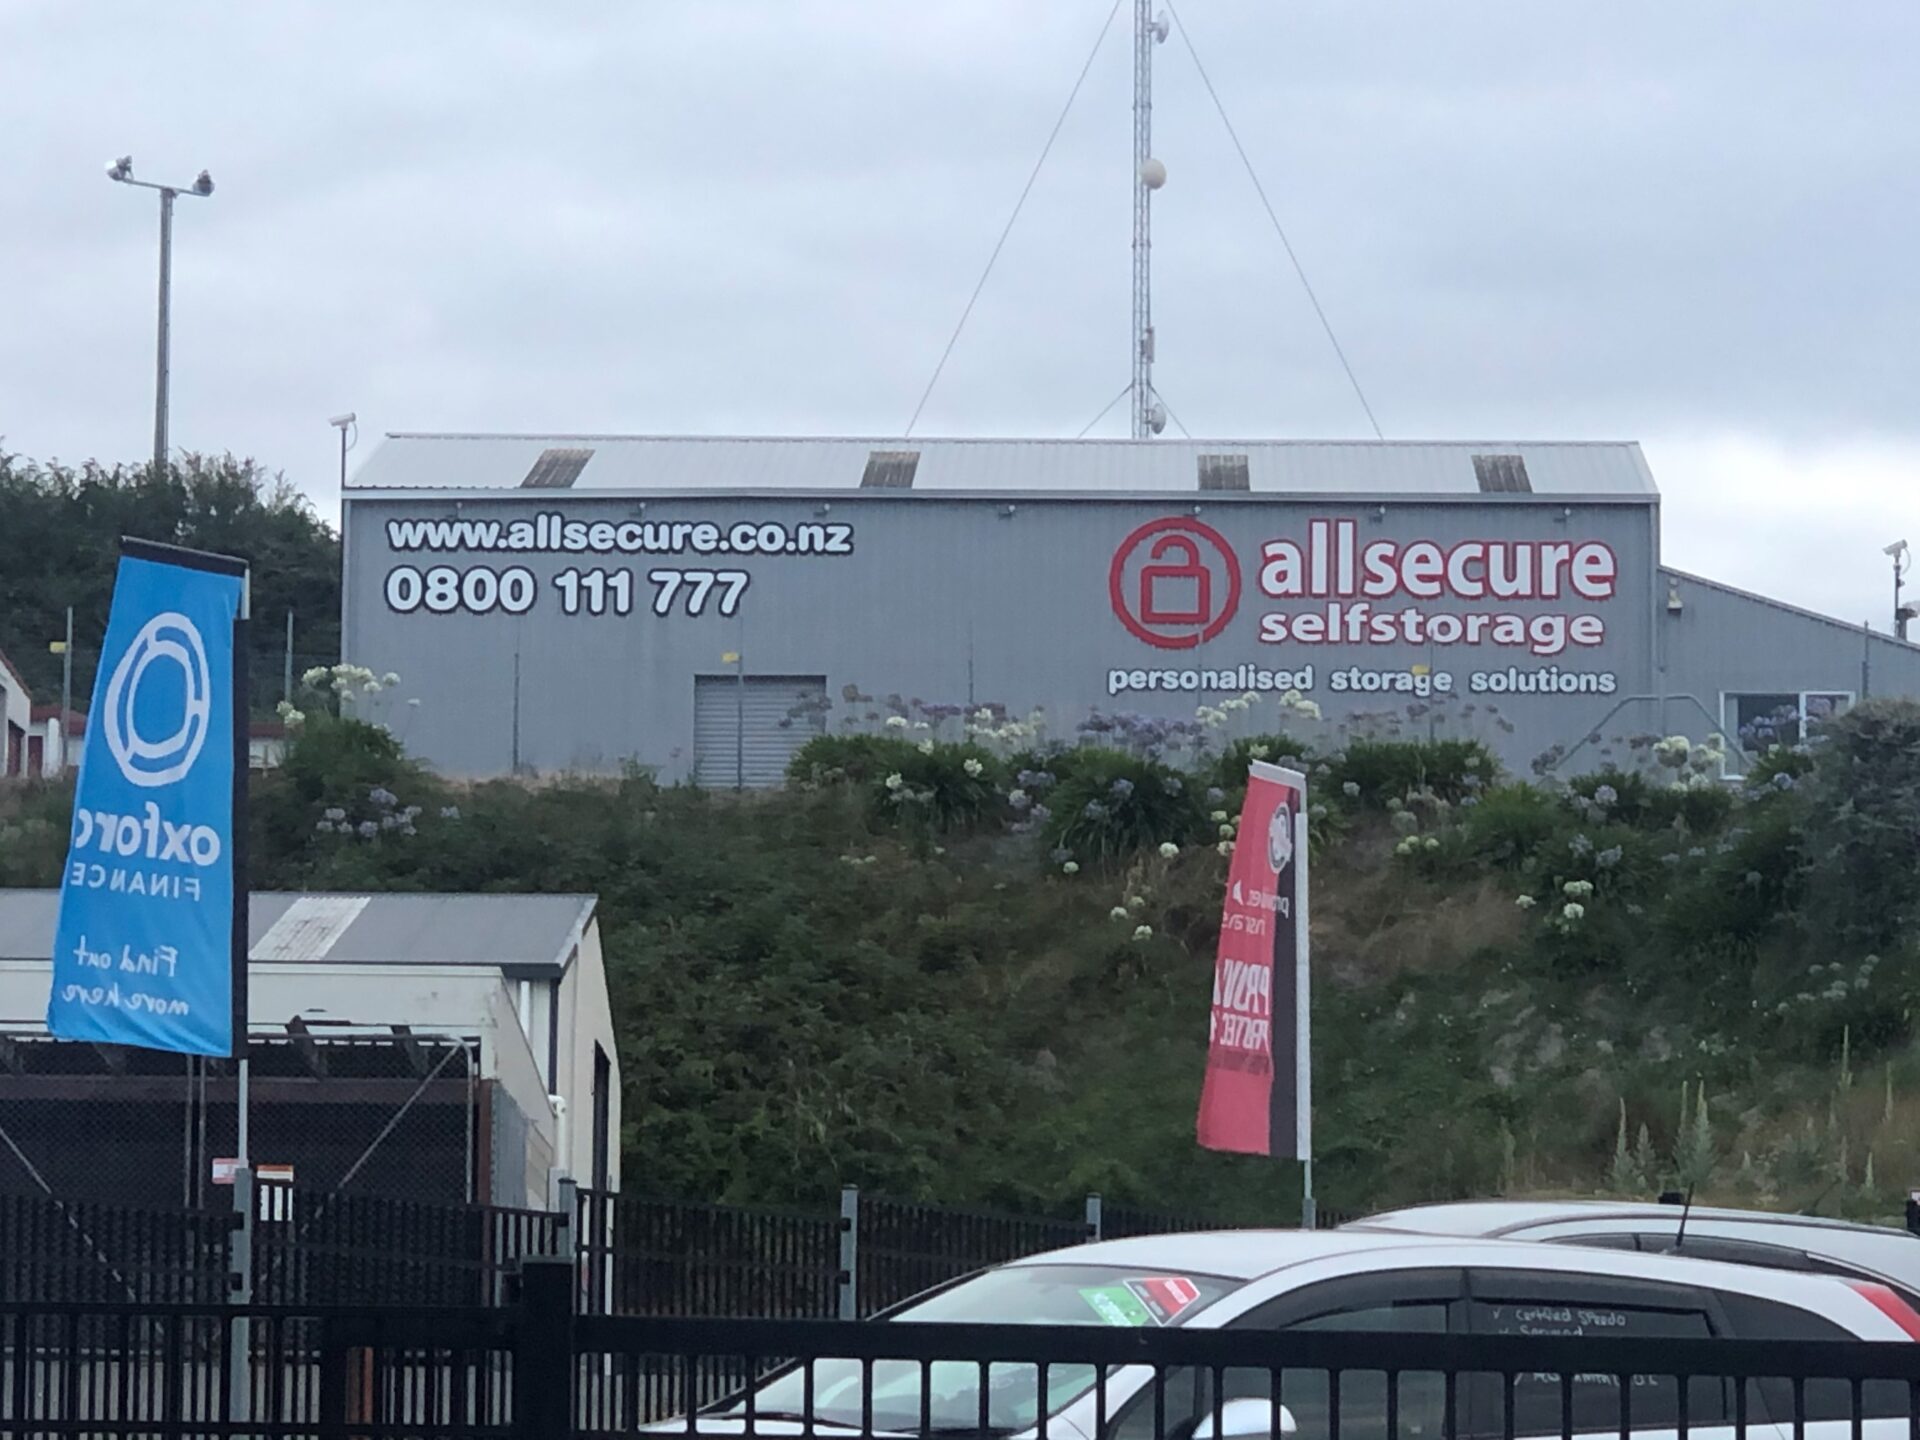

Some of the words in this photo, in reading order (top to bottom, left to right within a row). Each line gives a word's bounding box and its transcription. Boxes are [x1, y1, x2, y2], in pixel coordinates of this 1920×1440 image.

[387, 513, 853, 555] www.allsecure.co.nz
[1260, 518, 1617, 598] allsecure
[385, 564, 537, 614] 0800
[552, 567, 634, 615] 111
[648, 569, 751, 616] 777
[1259, 602, 1606, 654] selfstorage
[1107, 664, 1315, 694] personalised
[1330, 666, 1453, 698] storage
[1469, 666, 1617, 694] solutions
